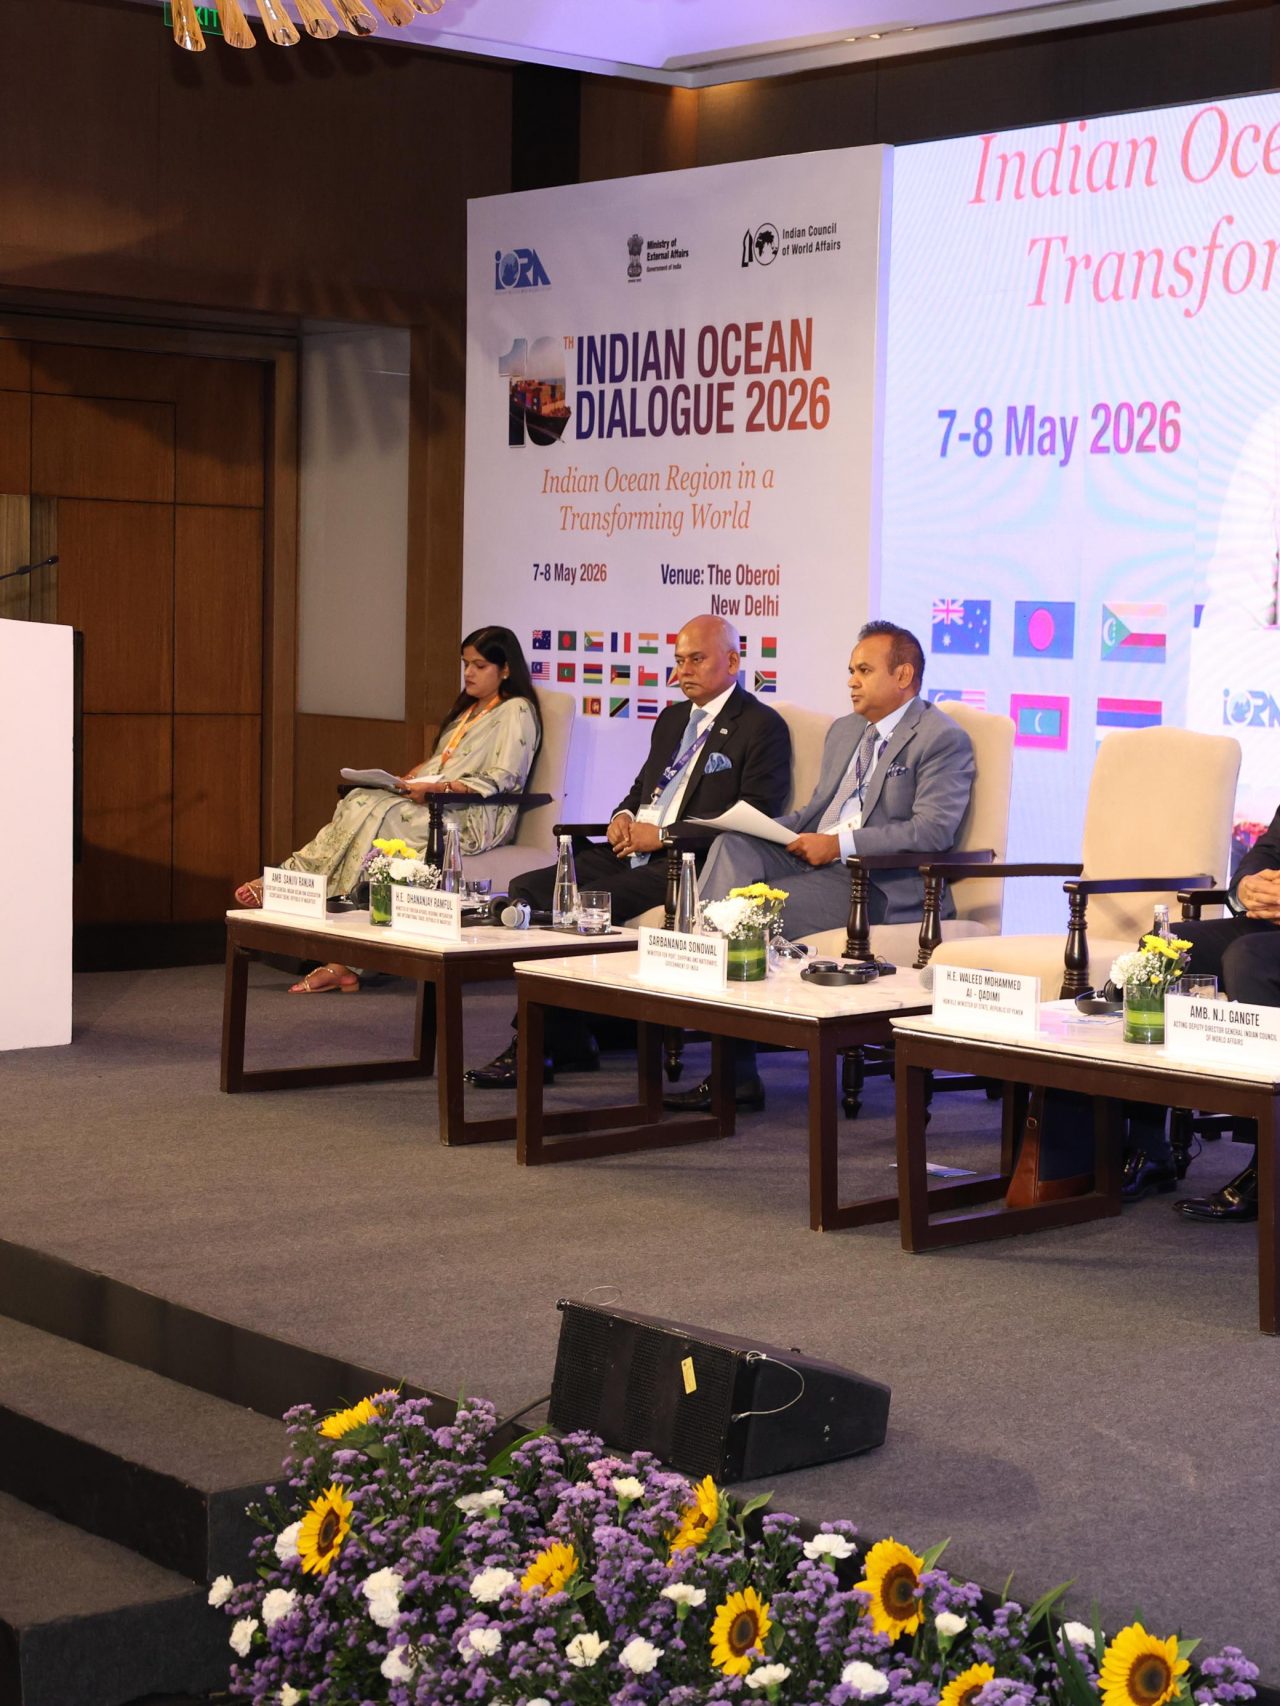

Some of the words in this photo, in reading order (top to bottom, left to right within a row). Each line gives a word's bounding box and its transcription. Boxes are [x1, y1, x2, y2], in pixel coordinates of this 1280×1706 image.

[968, 118, 1159, 204] Indian
[782, 227, 806, 240] Indian
[808, 222, 837, 237] Council
[647, 240, 670, 250] Ministry
[671, 238, 677, 248] of
[647, 250, 670, 261] External
[670, 249, 689, 258] Affairs
[782, 244, 790, 256] of
[792, 242, 813, 255] World
[814, 240, 841, 252] Affairs
[576, 327, 686, 386] INDIAN
[697, 317, 813, 378] OCEAN
[575, 381, 735, 440] DIALOGUE
[745, 375, 831, 433] 2026
[937, 405, 993, 458] 7-8
[1005, 405, 1079, 467] May
[1089, 399, 1181, 456] 2026
[541, 466, 600, 494] Indian
[604, 467, 660, 492] Ocean
[666, 463, 732, 498] Region
[737, 461, 757, 489] in
[761, 468, 775, 489] a
[559, 502, 684, 537] Transforming
[691, 500, 751, 530] World
[533, 563, 552, 582] 7-8
[554, 563, 577, 586] May
[580, 562, 607, 582] 2026
[661, 563, 704, 586] Venue:
[707, 564, 733, 586] The
[736, 563, 781, 587] Oberoi
[711, 594, 741, 616] New
[744, 594, 780, 617] Delhi
[648, 934, 686, 951] SARBANANDA
[688, 941, 717, 956] SONOWAL
[960, 972, 982, 985] WALEED
[984, 976, 1022, 990] MOHAMMED
[978, 990, 1000, 1002] QADIMI
[1190, 1005, 1210, 1020] AMB.
[1212, 1008, 1226, 1022] N.J.
[1229, 1010, 1260, 1026] GANGTE
[1204, 1024, 1224, 1034] DIRECTOR
[1244, 1030, 1258, 1038] INDIAN
[1260, 1032, 1278, 1042] COUNCIL
